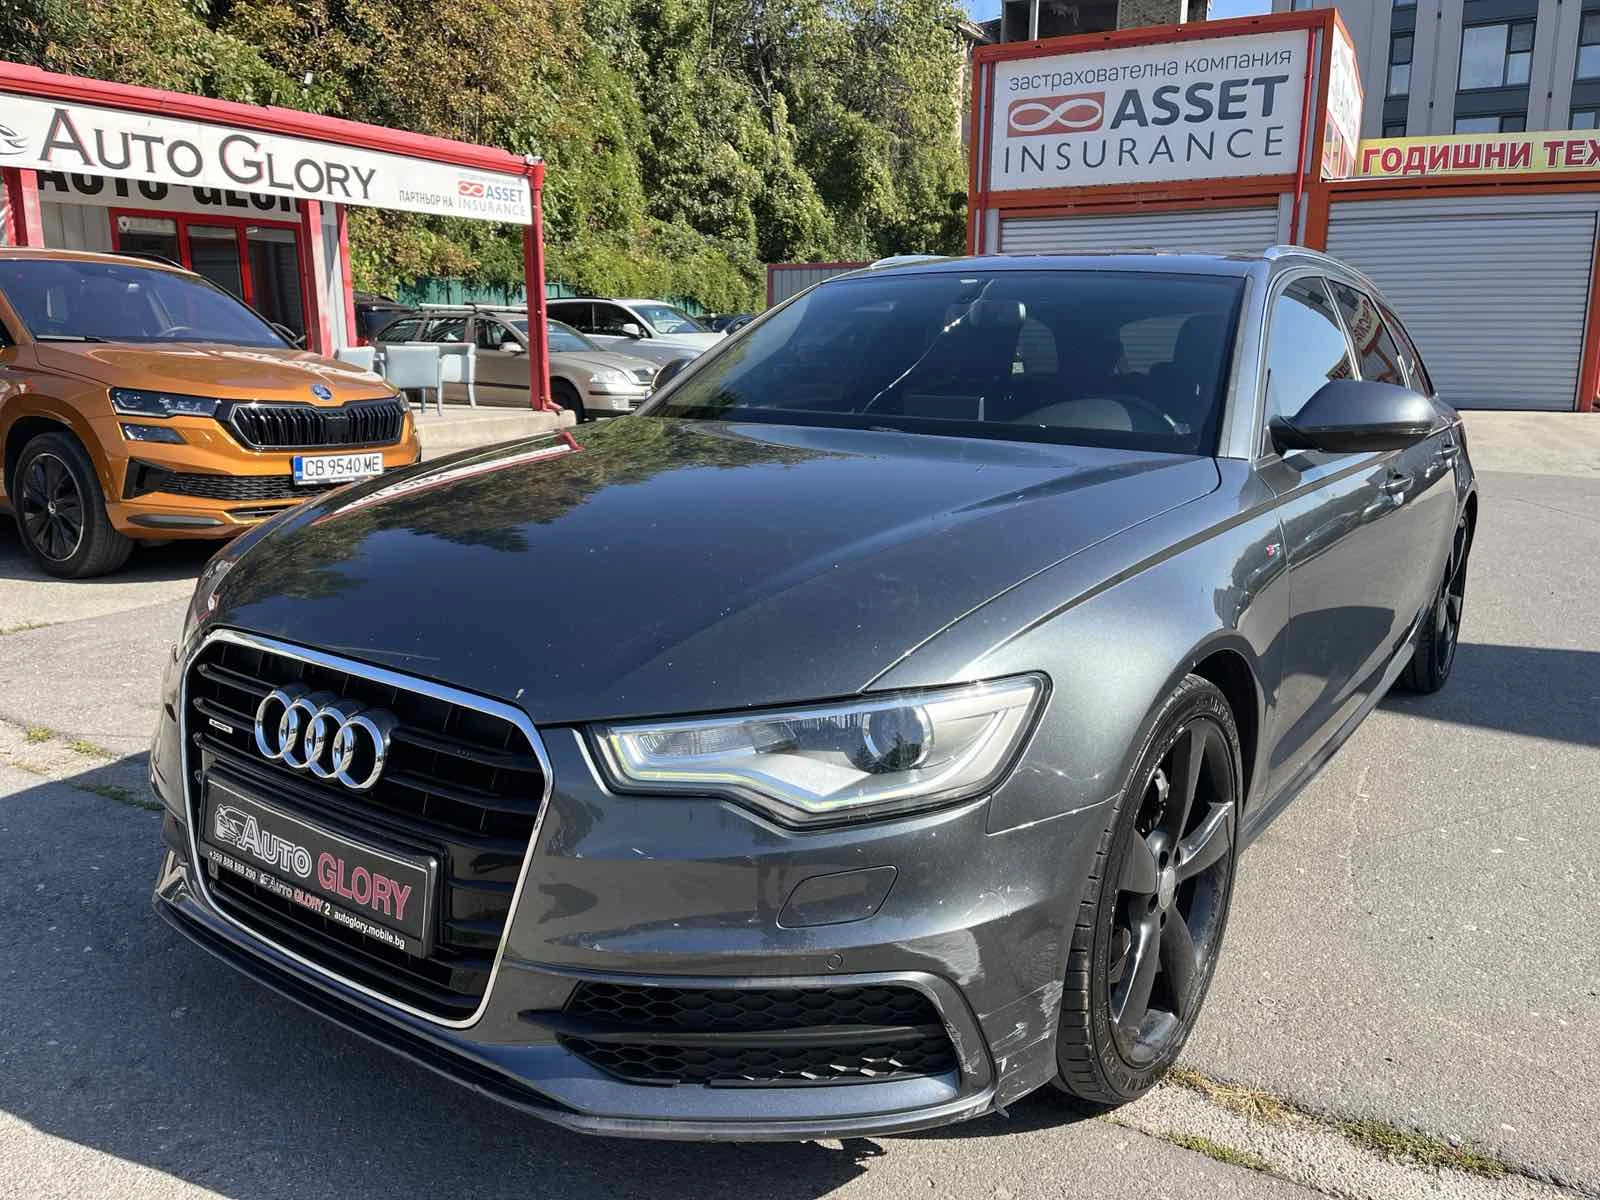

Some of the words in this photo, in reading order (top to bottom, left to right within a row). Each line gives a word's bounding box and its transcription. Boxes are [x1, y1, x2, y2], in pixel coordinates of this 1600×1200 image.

[1009, 56, 1179, 92] застрахователна
[1185, 48, 1292, 73] компания
[1110, 75, 1289, 130] ASSET
[39, 108, 203, 178] AUTO
[218, 133, 376, 199] GLORY
[1004, 125, 1284, 174] INSURANCE
[1362, 142, 1533, 176] ГОДИШНИ
[458, 198, 526, 217] INSURANCE
[486, 185, 524, 203] ASSET
[328, 457, 361, 475] 9540
[317, 852, 413, 921] GLORY
[324, 903, 332, 916] 2
[334, 910, 406, 950] autoglory.mobile.bg
